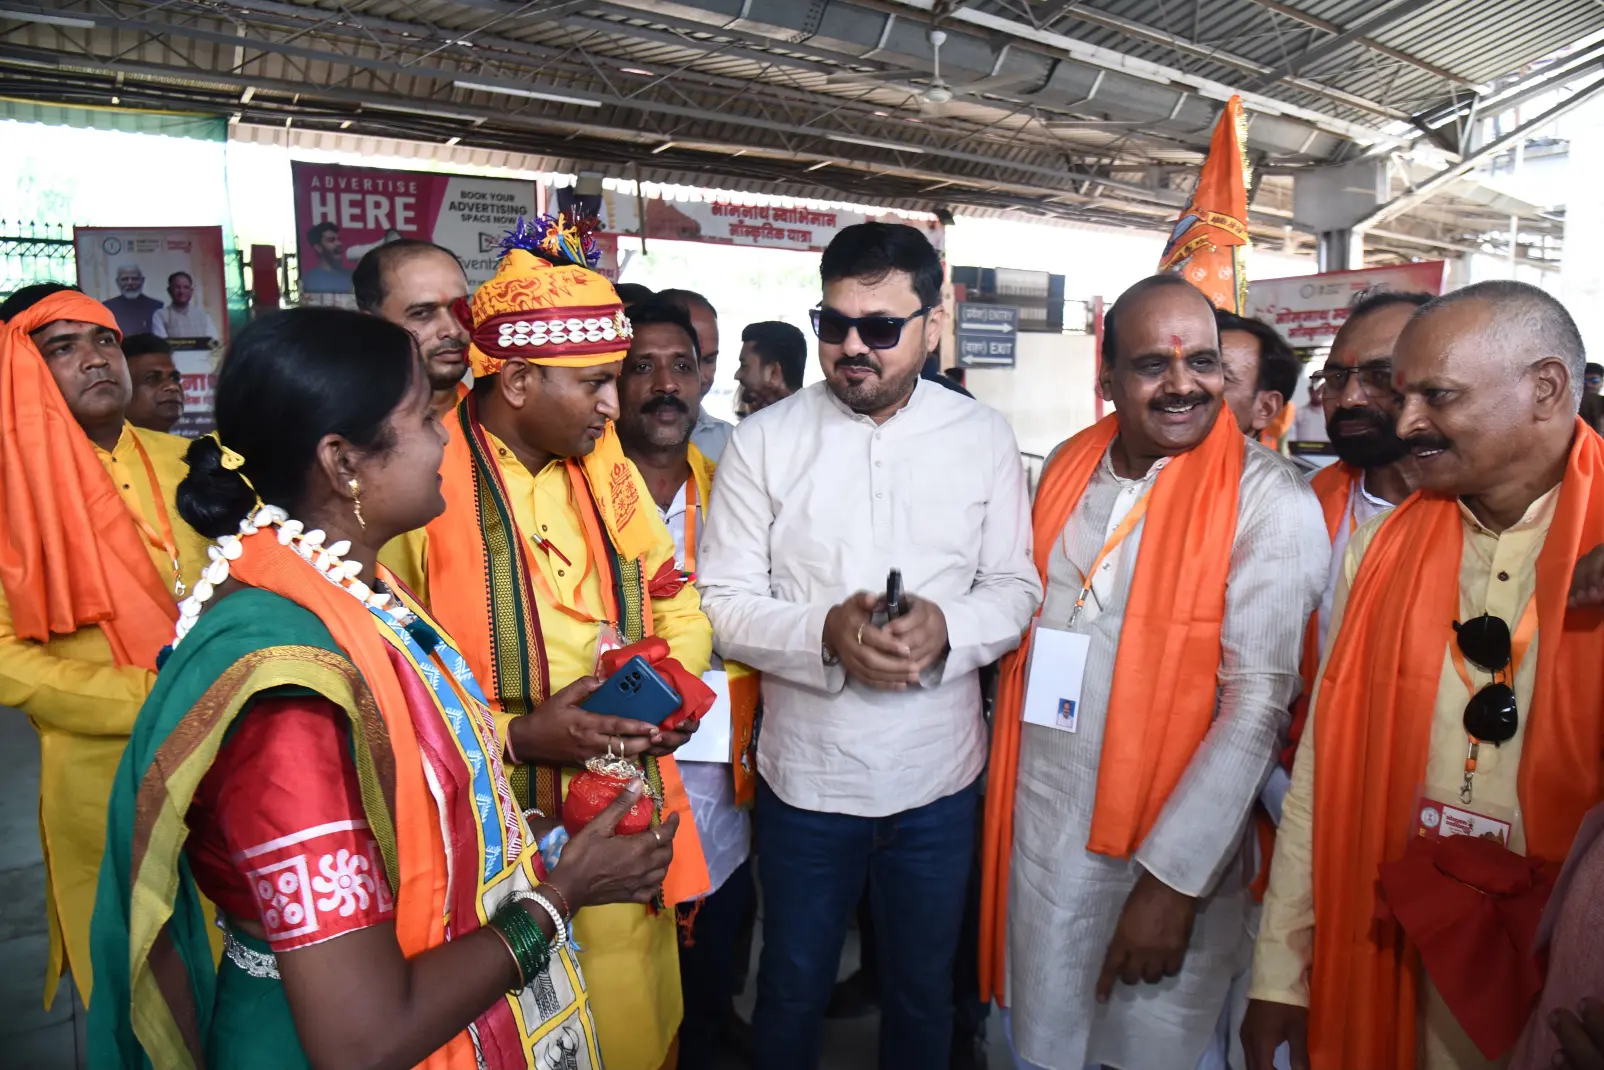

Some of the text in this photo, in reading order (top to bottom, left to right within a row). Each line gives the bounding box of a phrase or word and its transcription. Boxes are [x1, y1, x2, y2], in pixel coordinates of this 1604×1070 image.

[311, 174, 417, 193] ADVERTISE
[460, 190, 516, 202] BOOK YOUR
[311, 191, 417, 231] HERE
[448, 201, 527, 215] ADVERTISING
[460, 213, 517, 225] SPACE NOW
[456, 255, 499, 271] ventz
[988, 309, 1014, 321] ENTRY
[989, 342, 1013, 355] EXIT
